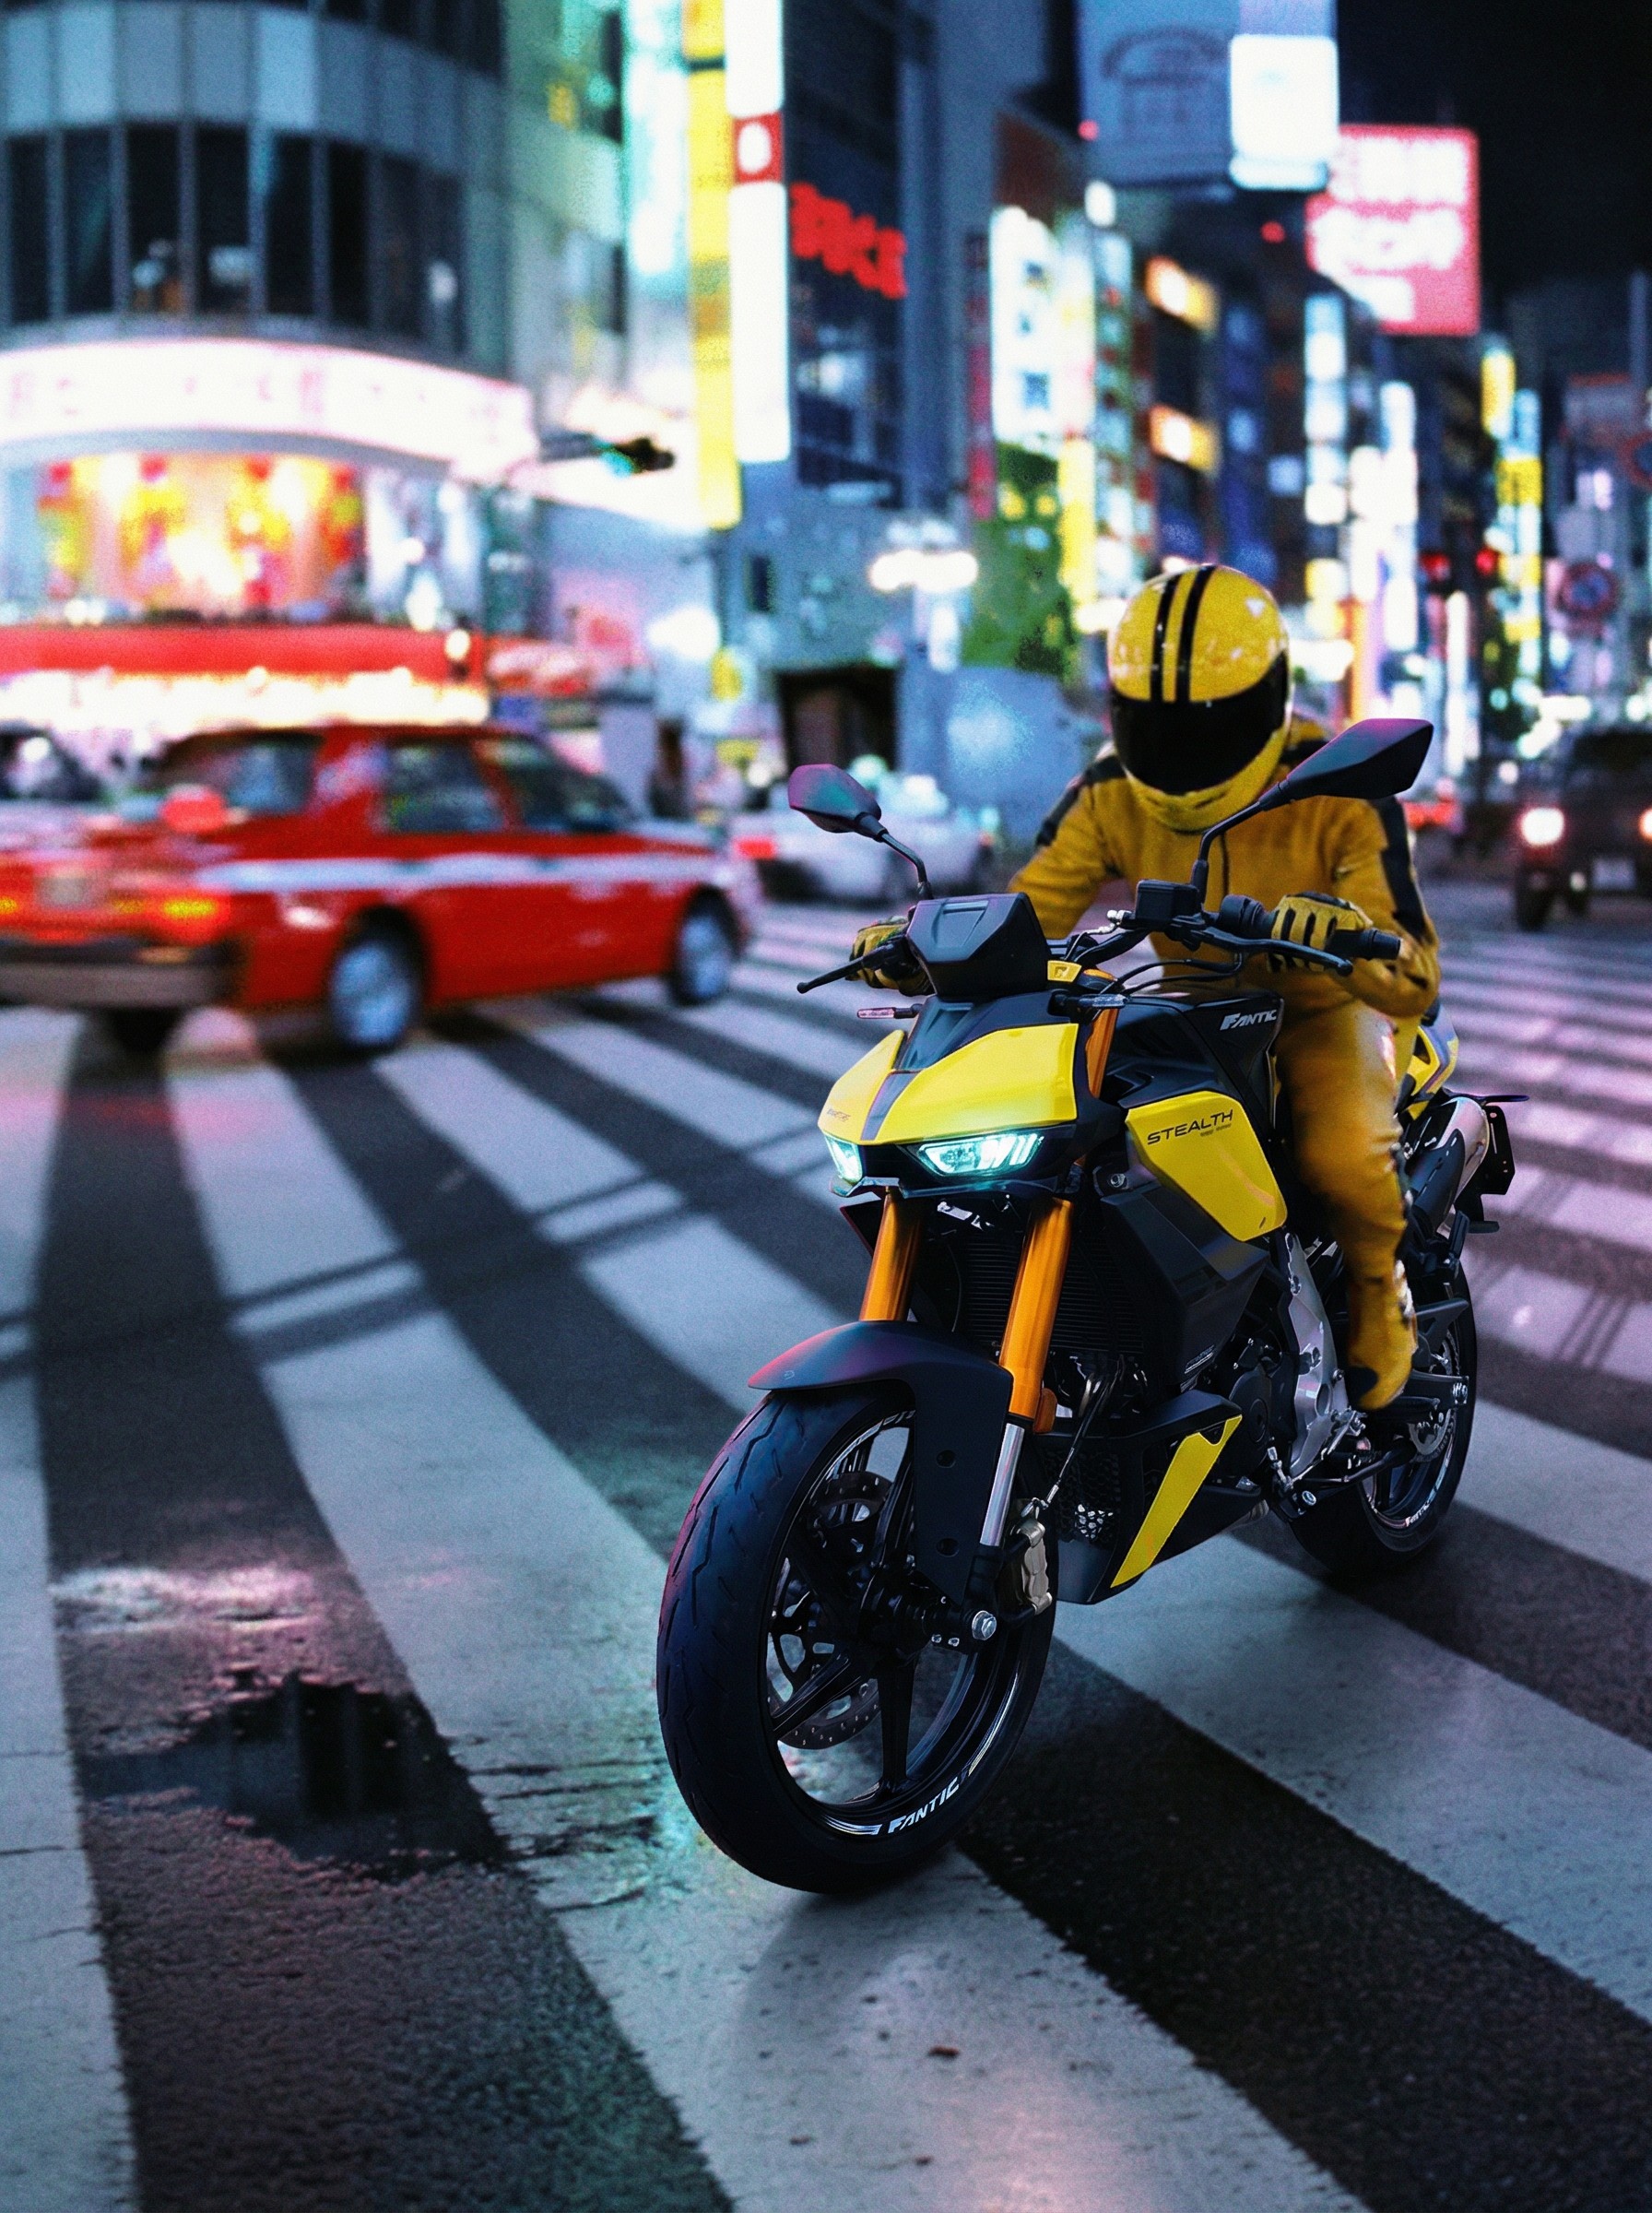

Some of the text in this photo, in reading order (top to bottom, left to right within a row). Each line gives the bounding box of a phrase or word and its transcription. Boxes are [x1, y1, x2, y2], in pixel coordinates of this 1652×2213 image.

[1220, 1010, 1277, 1031] FANTIC
[1147, 1109, 1233, 1145] STEALTH
[888, 1776, 960, 1834] FANTIC
